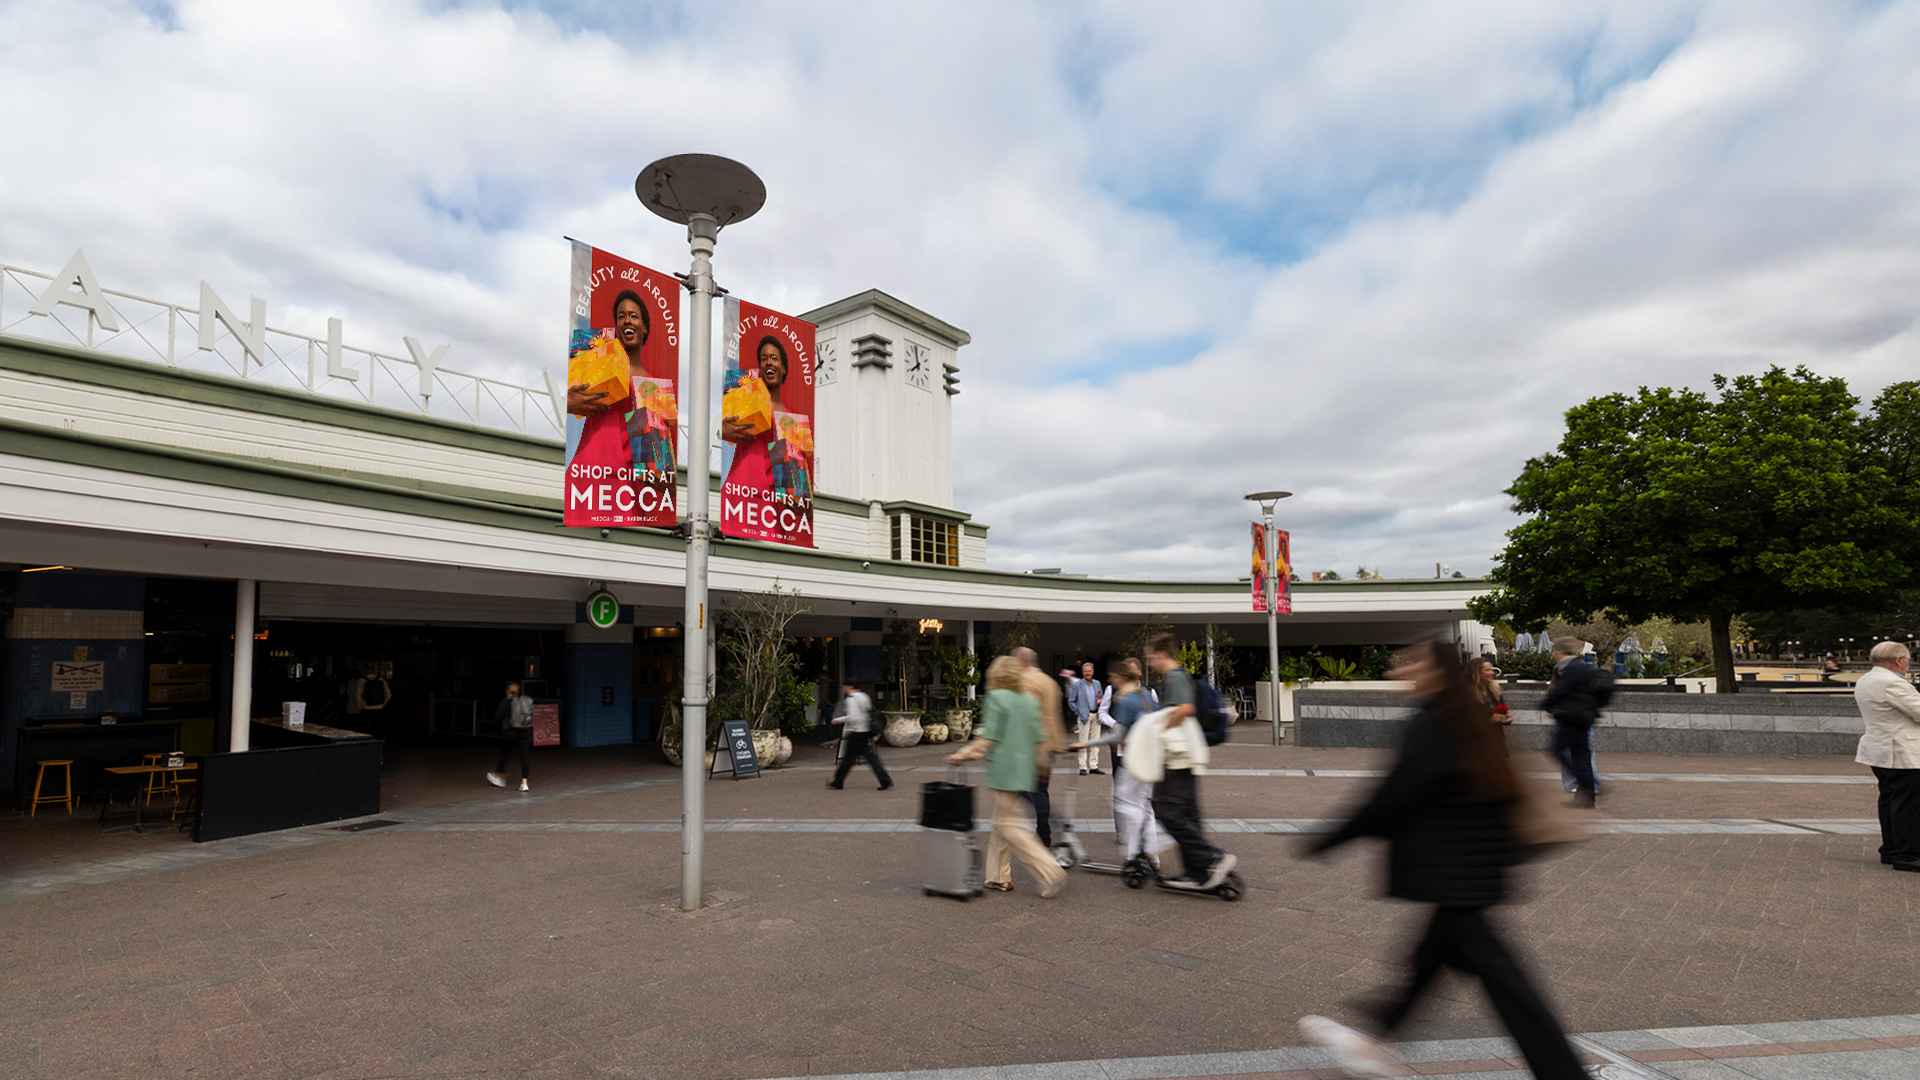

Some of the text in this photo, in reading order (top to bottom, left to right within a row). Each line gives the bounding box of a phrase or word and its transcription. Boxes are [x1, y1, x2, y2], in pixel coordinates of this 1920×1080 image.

[576, 265, 677, 346] BEAUTY all AROUND
[727, 315, 812, 385] BEAUTY all AROUND
[570, 463, 675, 484] SHOP GIFTS AT
[570, 483, 675, 512] MECCA
[725, 482, 811, 509] SHOP GIFTS AT
[725, 498, 812, 535] MECCA
[600, 601, 610, 620] F
[1306, 706, 1378, 719] MANLY
